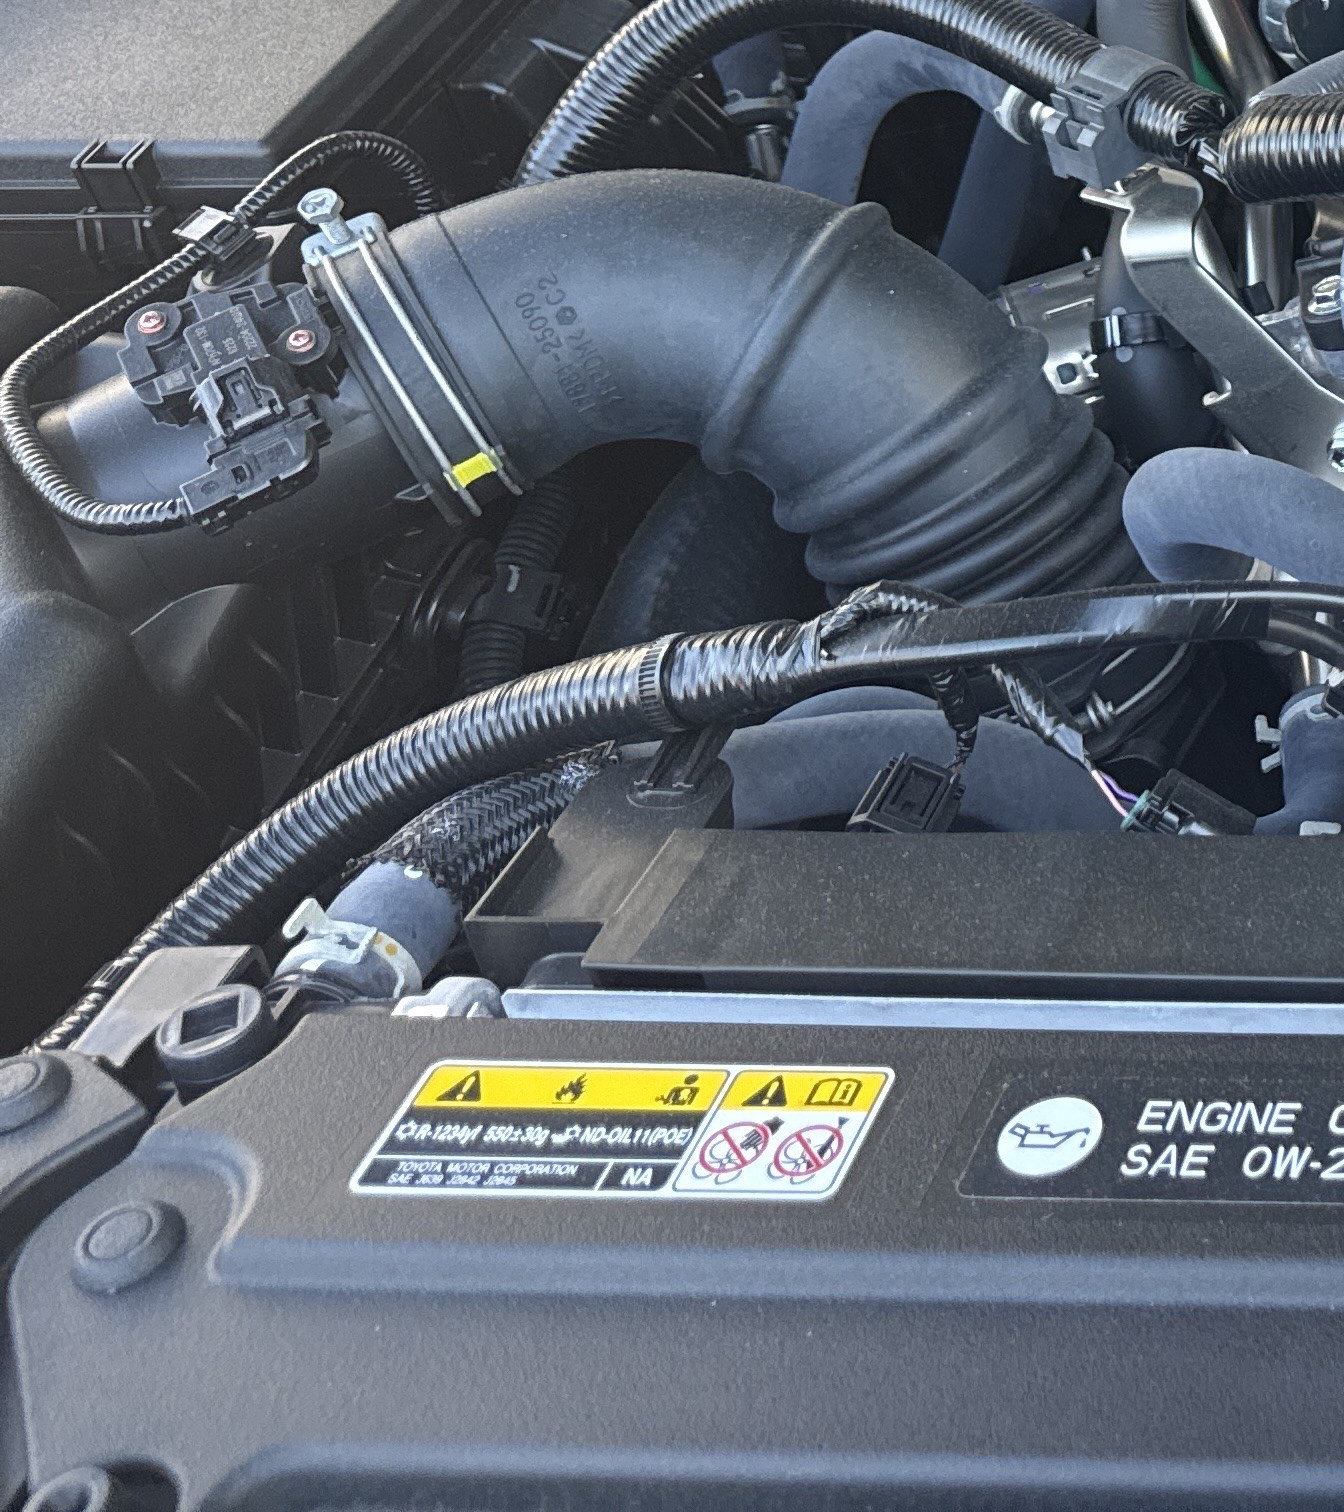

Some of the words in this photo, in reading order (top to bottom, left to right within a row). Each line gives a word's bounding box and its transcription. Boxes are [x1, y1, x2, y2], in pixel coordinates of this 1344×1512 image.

[1136, 1099, 1302, 1134] ENGINE
[414, 1123, 484, 1144] R-1234yf
[483, 1123, 550, 1147] 550±30g
[397, 1161, 443, 1173] TOYOTA
[446, 1162, 491, 1174] MOTOR
[493, 1163, 580, 1176] CORPORATION
[1120, 1142, 1216, 1178] SAE
[387, 1173, 415, 1185] SAE
[619, 1167, 654, 1186] NA
